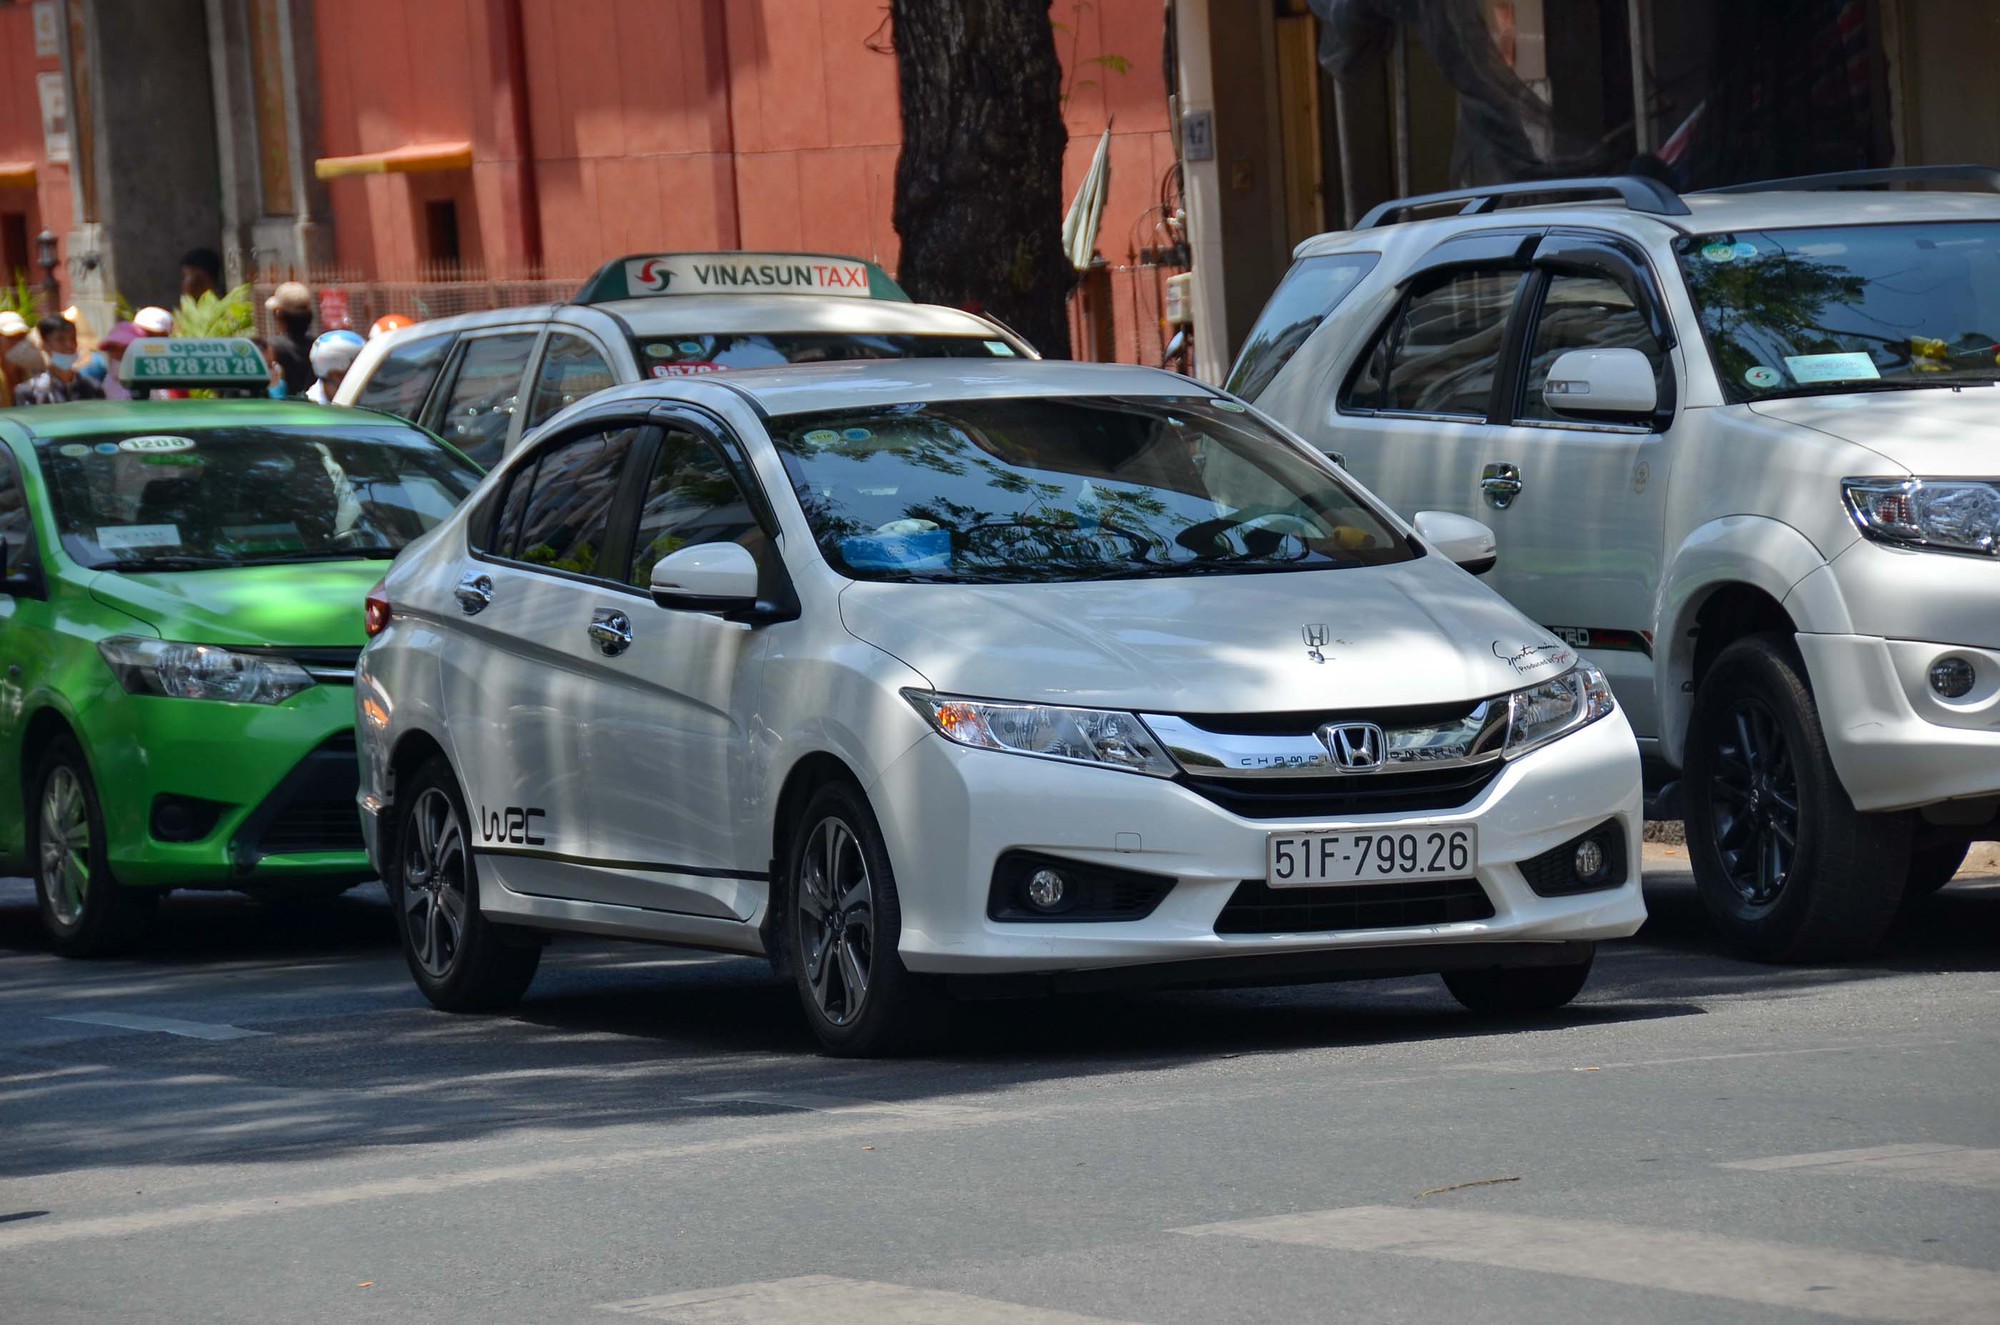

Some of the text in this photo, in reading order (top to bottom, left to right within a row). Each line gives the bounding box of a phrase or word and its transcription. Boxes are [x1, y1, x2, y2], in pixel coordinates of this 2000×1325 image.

[143, 357, 258, 375] 38 28 28 28
[1553, 627, 1590, 647] TRD
[1275, 831, 1468, 879] 51F-799.26
